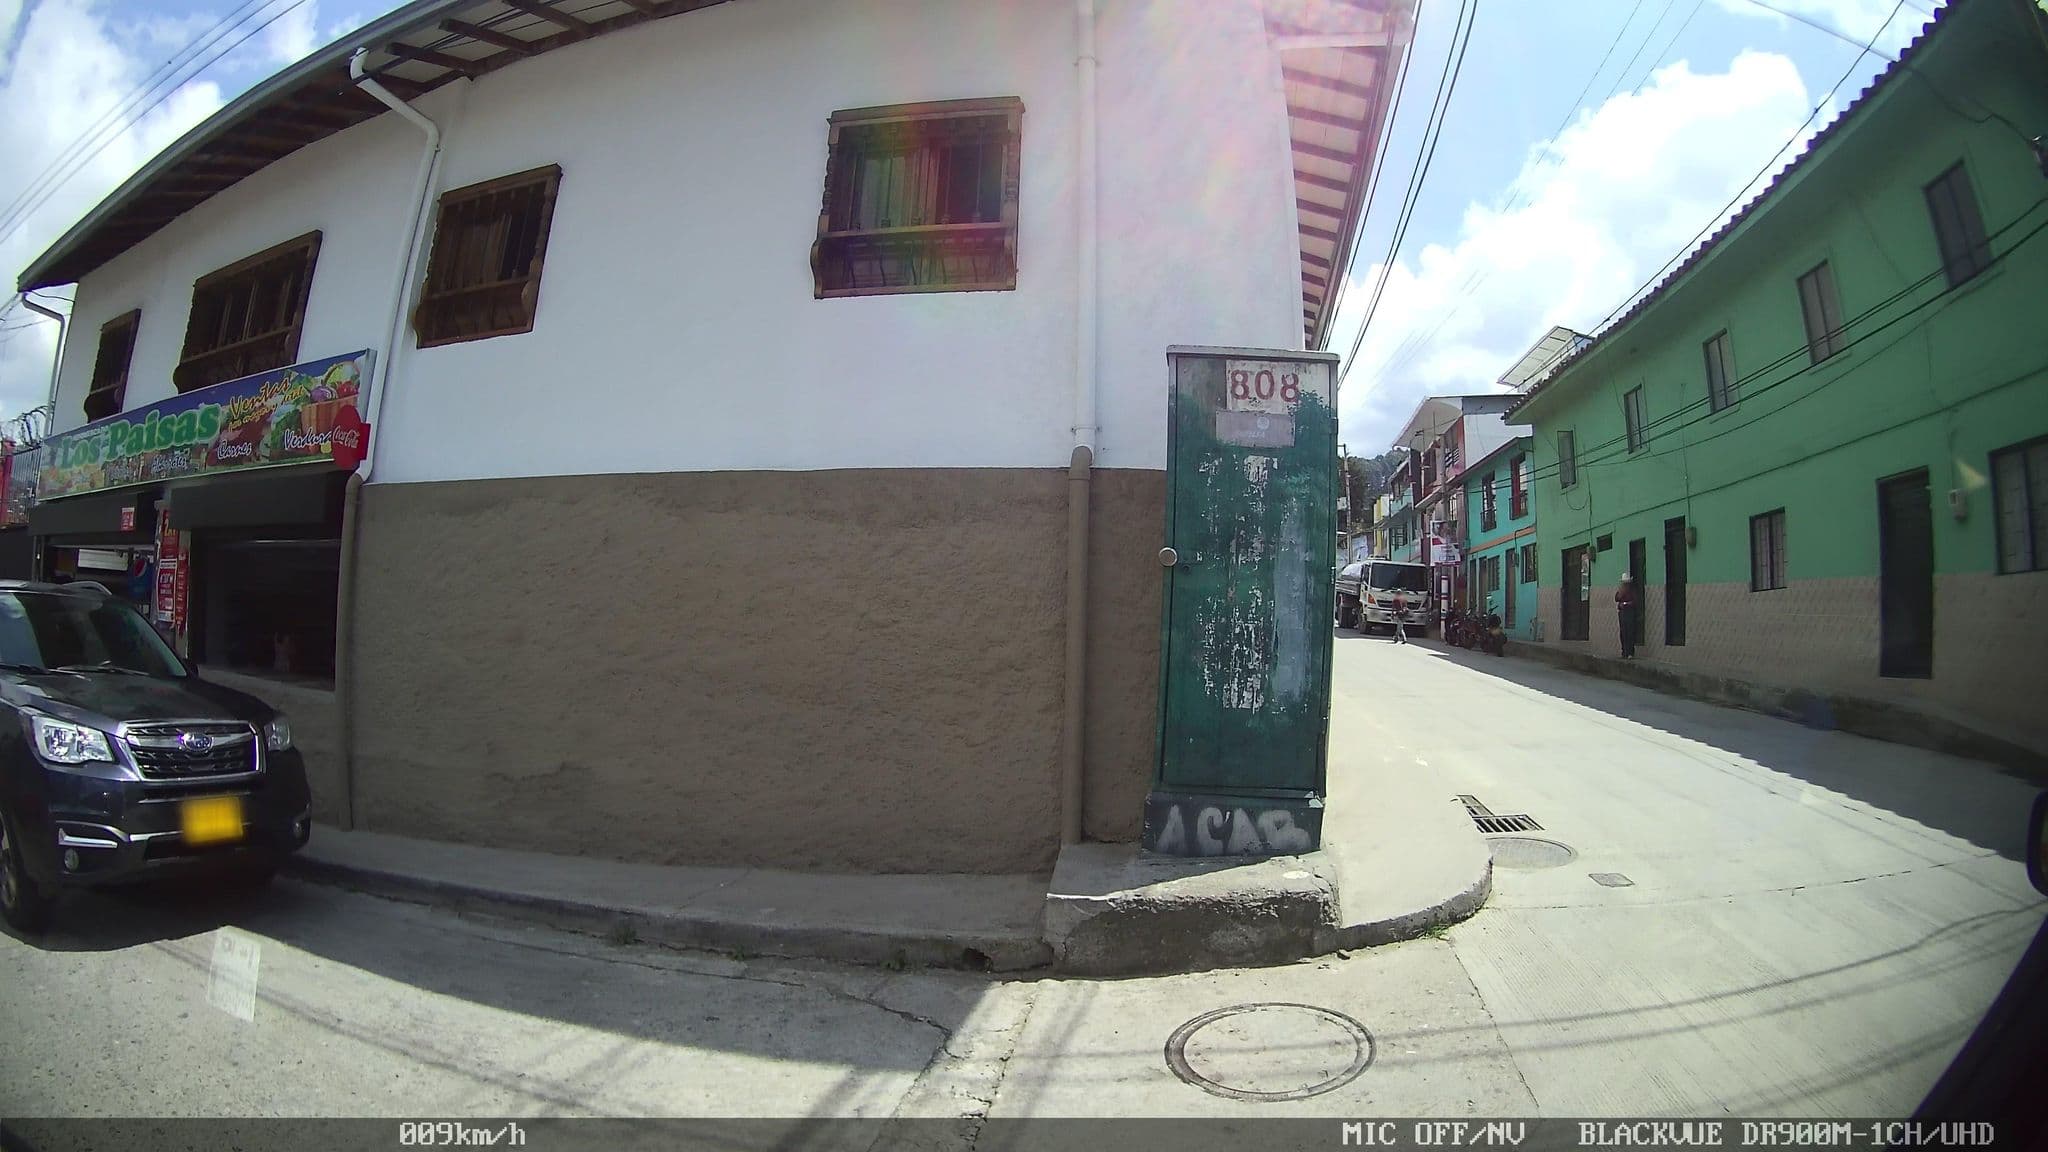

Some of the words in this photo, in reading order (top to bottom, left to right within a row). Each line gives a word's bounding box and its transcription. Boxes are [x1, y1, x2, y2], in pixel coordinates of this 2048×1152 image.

[229, 376, 291, 420] Ventas
[1230, 369, 1299, 402] 808
[61, 436, 100, 469] Los
[106, 404, 221, 461] Paisas
[217, 439, 252, 460] Carnes
